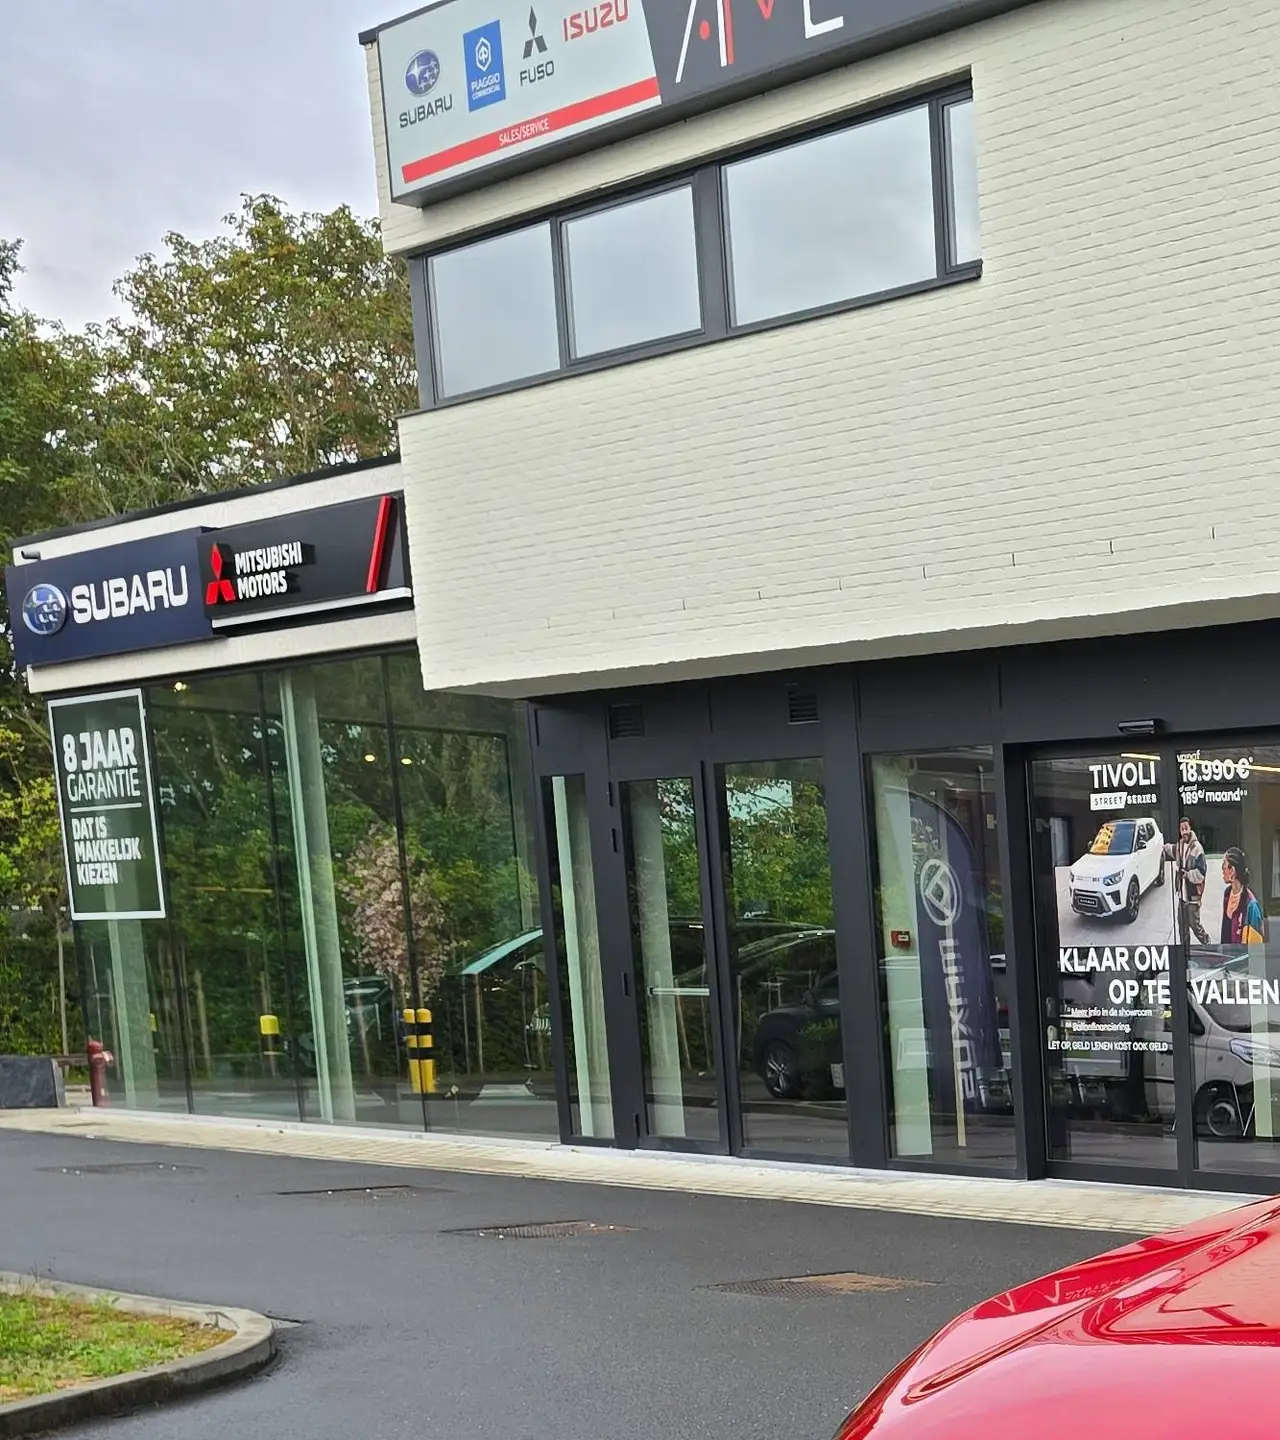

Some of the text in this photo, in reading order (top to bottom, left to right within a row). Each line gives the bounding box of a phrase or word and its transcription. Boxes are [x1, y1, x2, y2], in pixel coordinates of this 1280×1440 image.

[563, 0, 629, 42] ISUZU
[470, 72, 500, 92] PIAGGIO
[519, 60, 555, 87] FUSO
[399, 93, 453, 128] SUBARU
[498, 118, 550, 146] SALES/SERVICE
[234, 540, 304, 575] MITSUBISHI
[71, 564, 189, 625] SUBARU
[236, 569, 288, 600] MOTORS
[62, 727, 138, 773] 8 JAAR
[66, 767, 141, 802] GARANTIE
[1088, 761, 1156, 789] TIVOLI
[1093, 793, 1157, 806] STREET SERIES
[71, 815, 108, 841] DAT IS
[74, 837, 142, 863] MAKKELIJK
[76, 862, 119, 886] KIEZEN
[1059, 945, 1170, 973] KLAAR OM
[1108, 978, 1139, 1004] OP
[1142, 978, 1171, 1005] TE
[1189, 978, 1279, 1005] VALLEN
[1118, 1007, 1153, 1017] showroom
[1047, 1040, 1061, 1050] LET
[1072, 1041, 1090, 1050] GELD
[1091, 1041, 1113, 1051] LENEN
[1114, 1041, 1132, 1051] KOST
[1132, 1041, 1149, 1051] OOK
[1149, 1041, 1168, 1051] GELD
